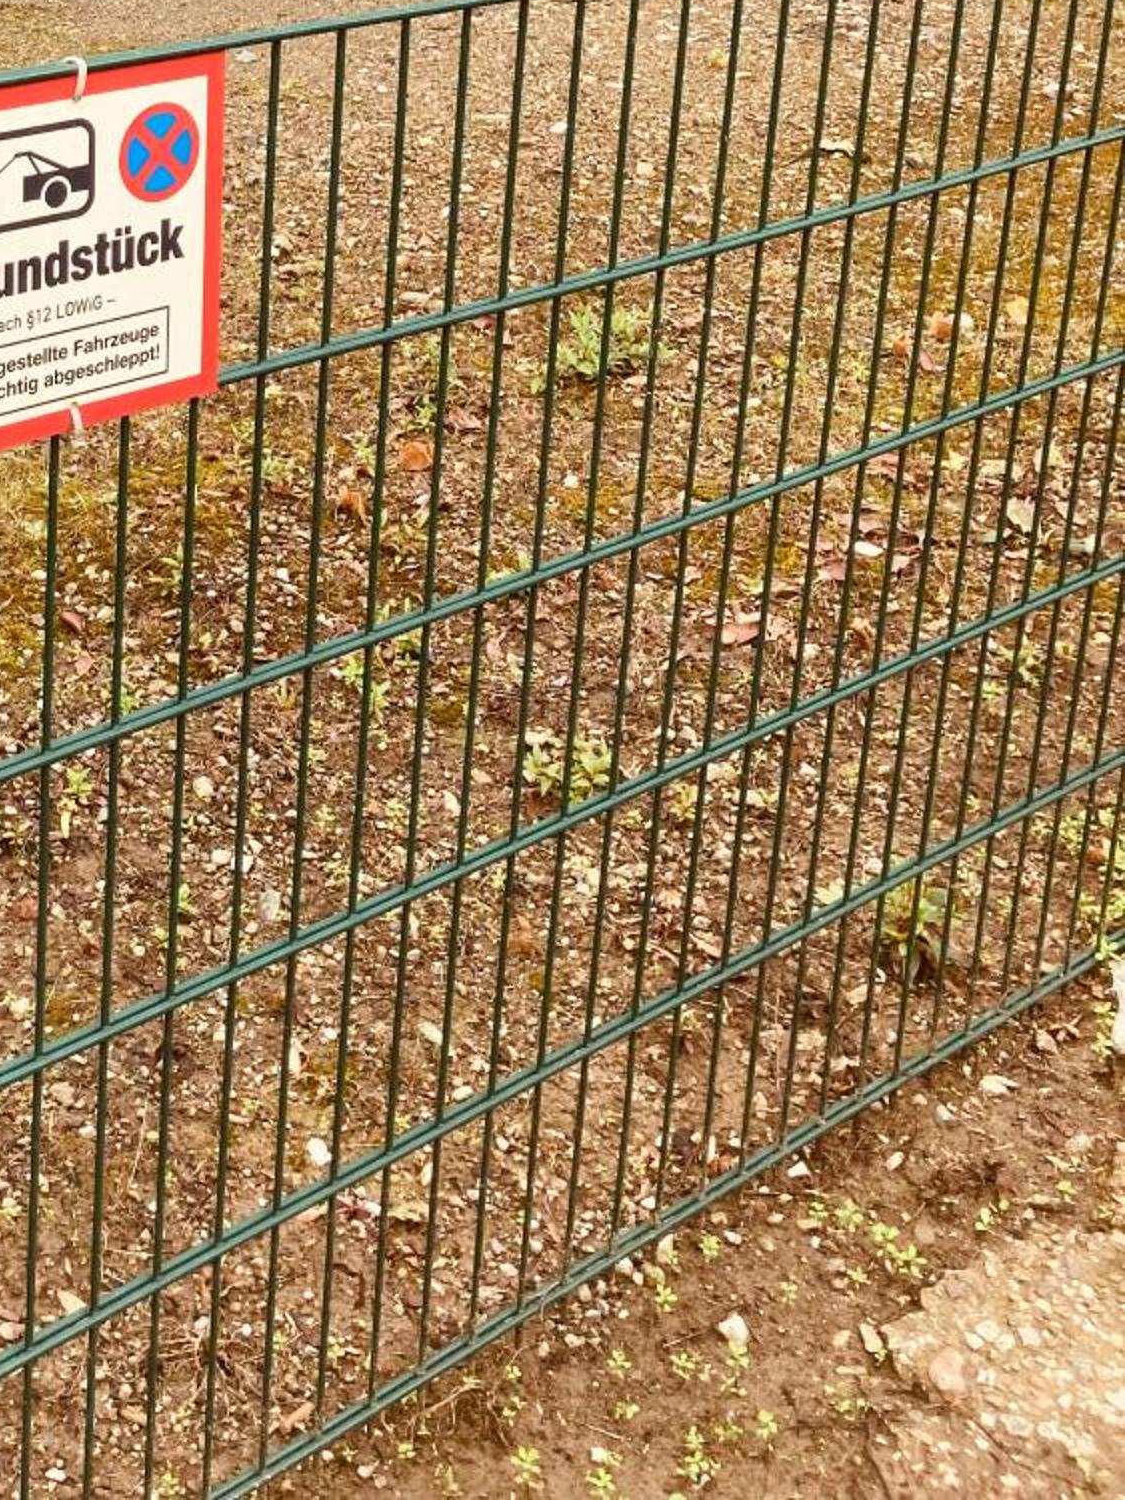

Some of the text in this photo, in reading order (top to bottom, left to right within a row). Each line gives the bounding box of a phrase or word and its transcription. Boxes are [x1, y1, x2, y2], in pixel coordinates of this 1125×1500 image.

[26, 306, 51, 331] §12
[74, 324, 160, 356] Fahrzeuge
[44, 344, 160, 389] abgeschleppt!
